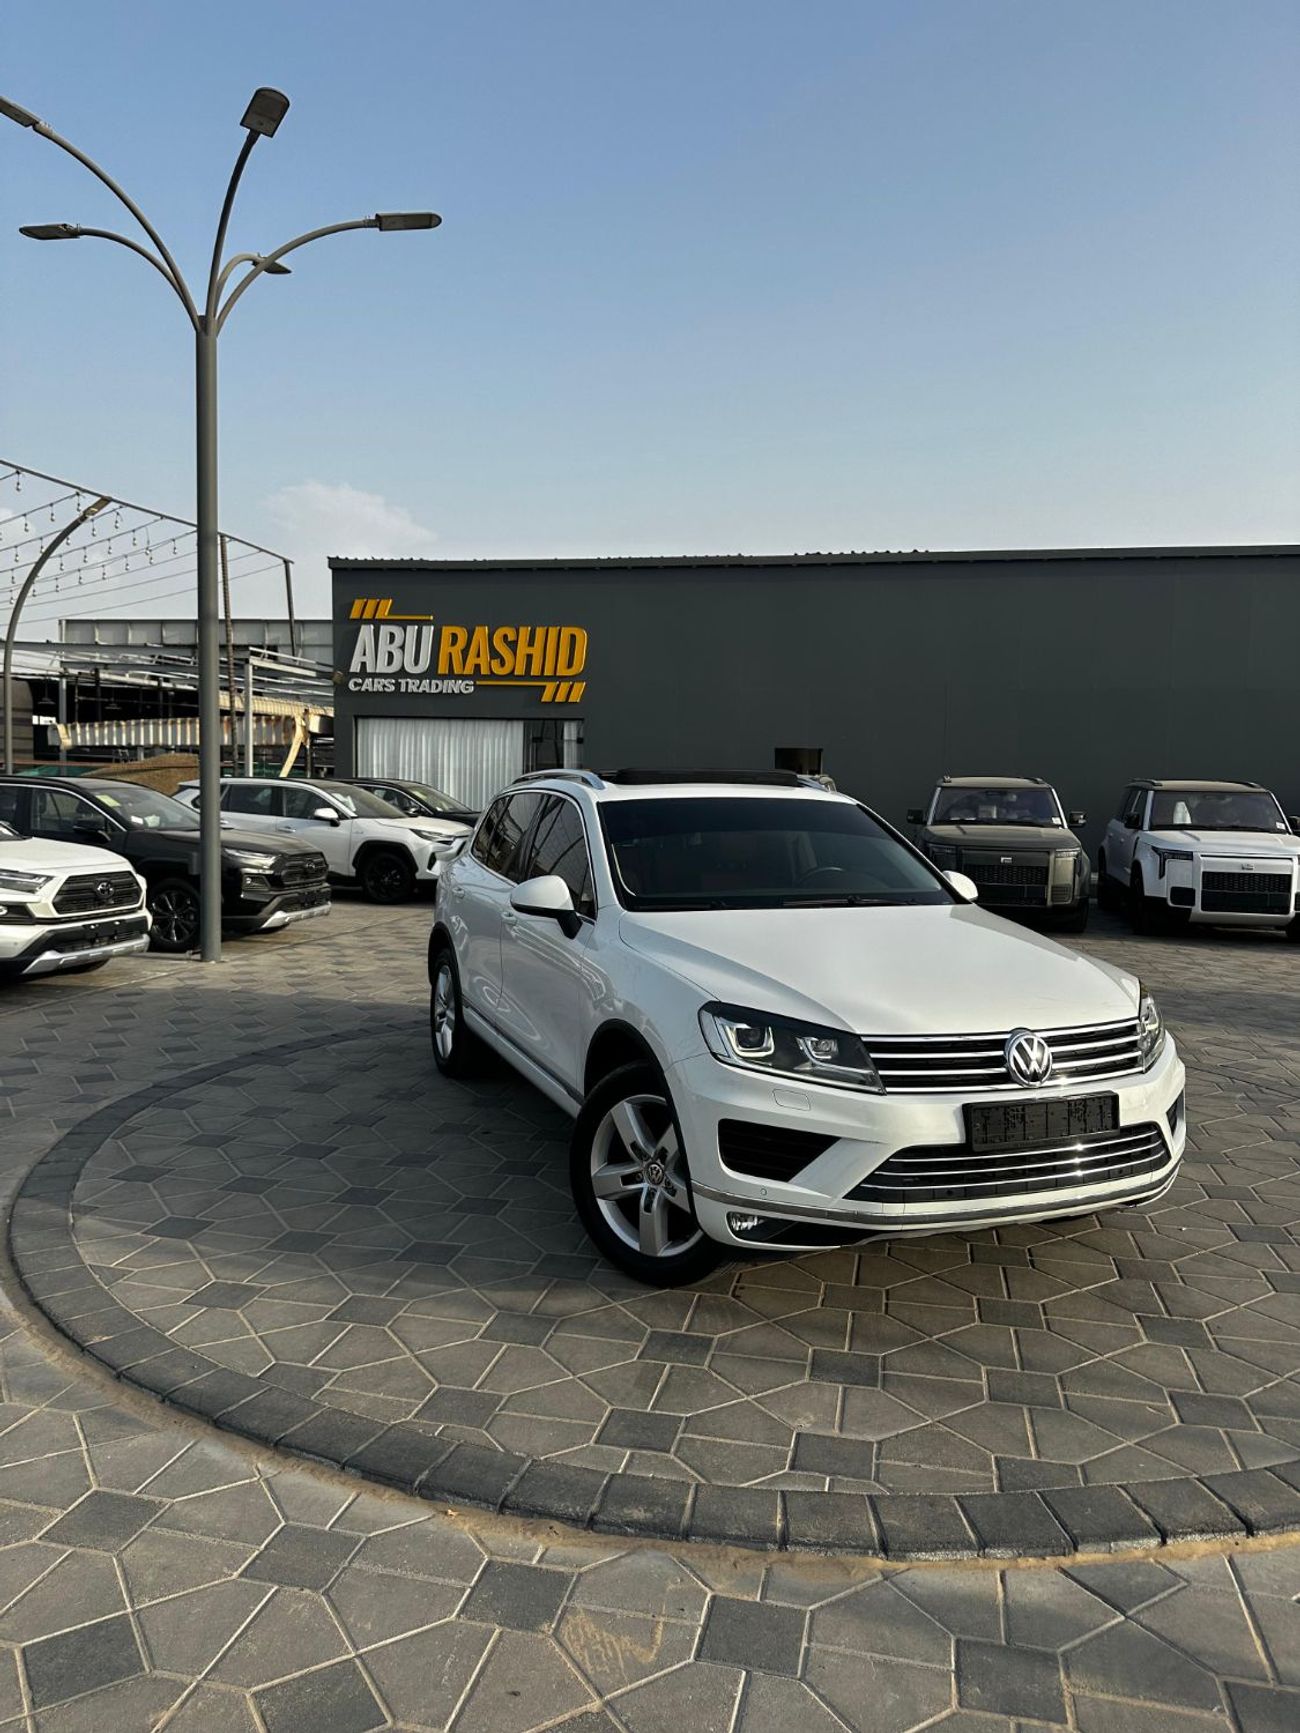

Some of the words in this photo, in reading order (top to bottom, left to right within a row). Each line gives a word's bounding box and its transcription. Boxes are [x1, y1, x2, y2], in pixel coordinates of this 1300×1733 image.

[349, 624, 434, 674] ABU
[437, 625, 588, 676] RASHID
[348, 678, 396, 693] CARS
[398, 678, 474, 694] TRADING
